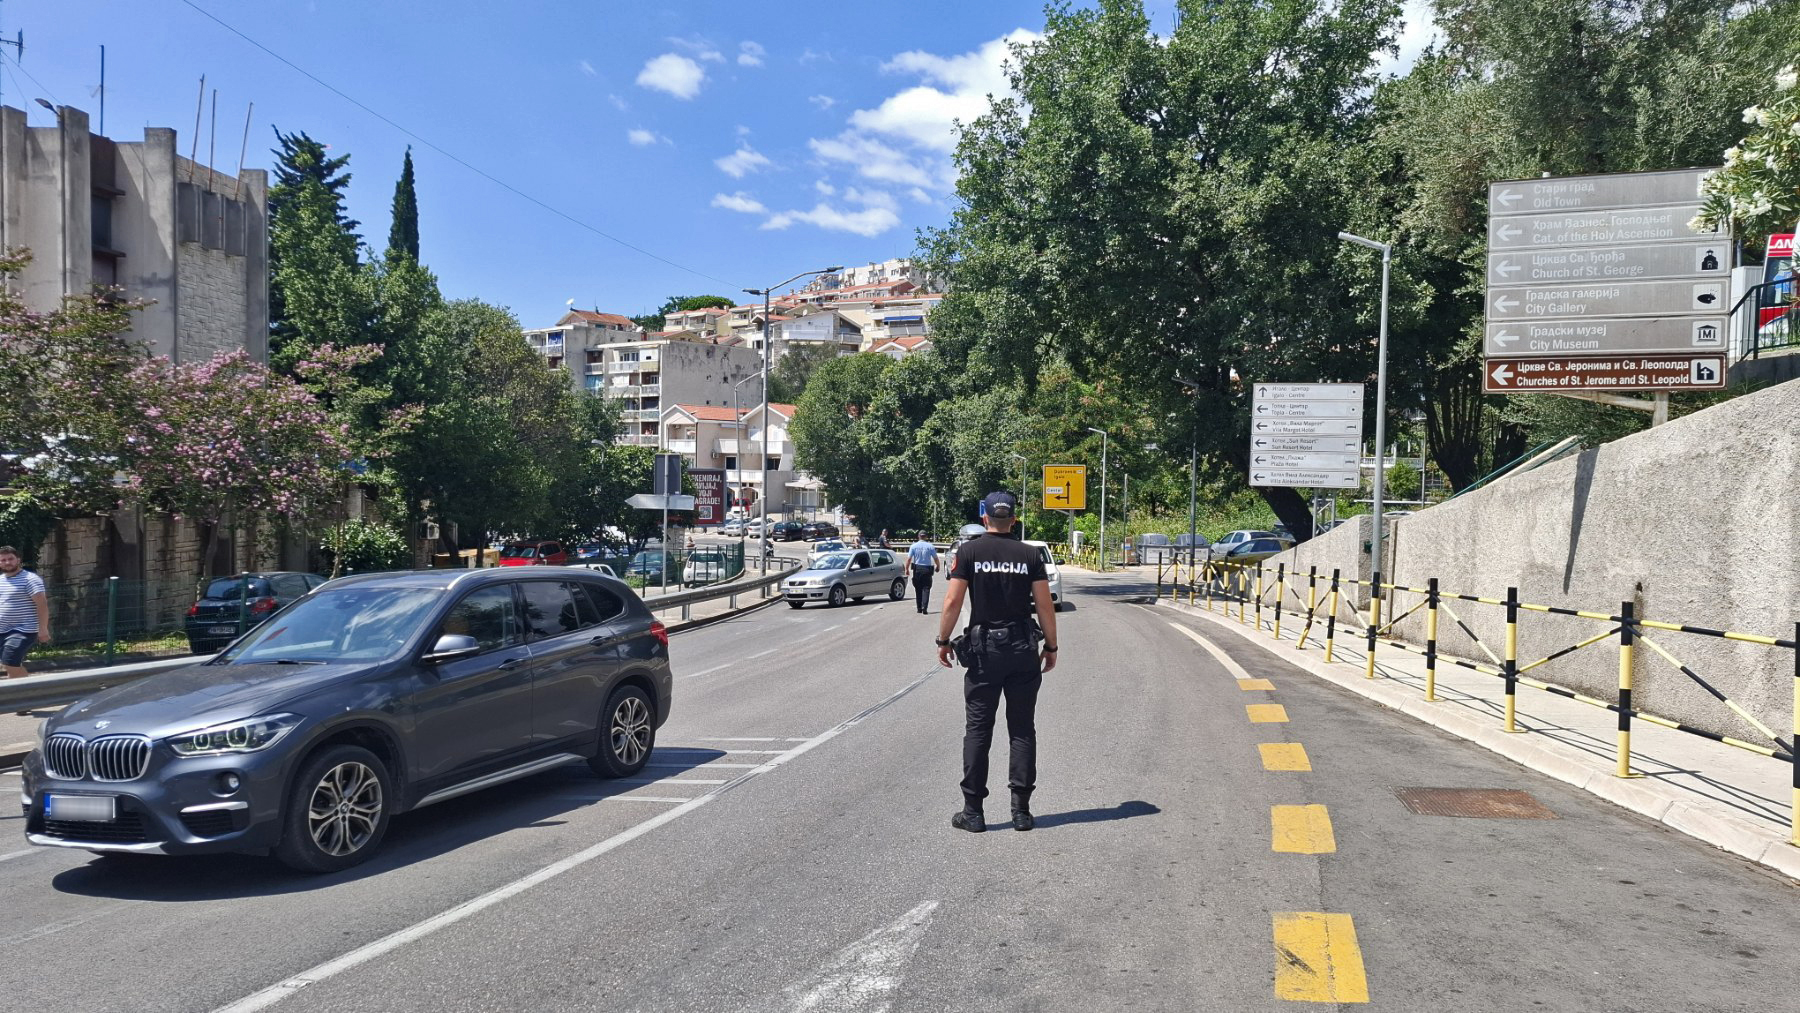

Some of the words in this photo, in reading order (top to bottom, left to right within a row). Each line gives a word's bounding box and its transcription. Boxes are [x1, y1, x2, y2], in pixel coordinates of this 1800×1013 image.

[1534, 184, 1567, 195] Стари
[1570, 182, 1594, 193] град
[1533, 196, 1552, 208] Old
[1554, 197, 1581, 207] Town
[1533, 220, 1562, 231] Храм
[1533, 233, 1554, 244] Cat.
[1557, 232, 1569, 242] of
[1570, 231, 1588, 242] the
[1590, 230, 1615, 241] Holy
[1616, 228, 1673, 240] Ascension
[1532, 255, 1567, 266] Црква
[1570, 252, 1587, 263] Св.
[1532, 268, 1570, 278] Church
[1572, 266, 1584, 277] of
[1586, 266, 1600, 276] St.
[1604, 264, 1644, 276] George
[1526, 290, 1570, 302] Градска
[1572, 288, 1620, 300] галерија
[1526, 303, 1546, 315] City
[1548, 302, 1586, 314] Gallery
[1530, 326, 1574, 338] Градски
[1576, 324, 1607, 336] музеј
[1530, 340, 1550, 352] City
[1552, 340, 1599, 350] Museum
[1517, 362, 1546, 373] Цркве
[1548, 361, 1563, 371] Св.
[1566, 360, 1612, 372] Јеронима
[1614, 362, 1620, 370] и
[1622, 360, 1638, 370] Св.
[1640, 360, 1689, 370] Леополда
[1516, 376, 1558, 386] Churches
[1560, 376, 1568, 386] of
[1570, 376, 1582, 386] St.
[1584, 376, 1617, 386] Jerome
[1619, 375, 1636, 385] and
[1638, 375, 1650, 385] St.
[1652, 374, 1689, 386] Leopold
[974, 561, 1028, 574] POLICIJA
